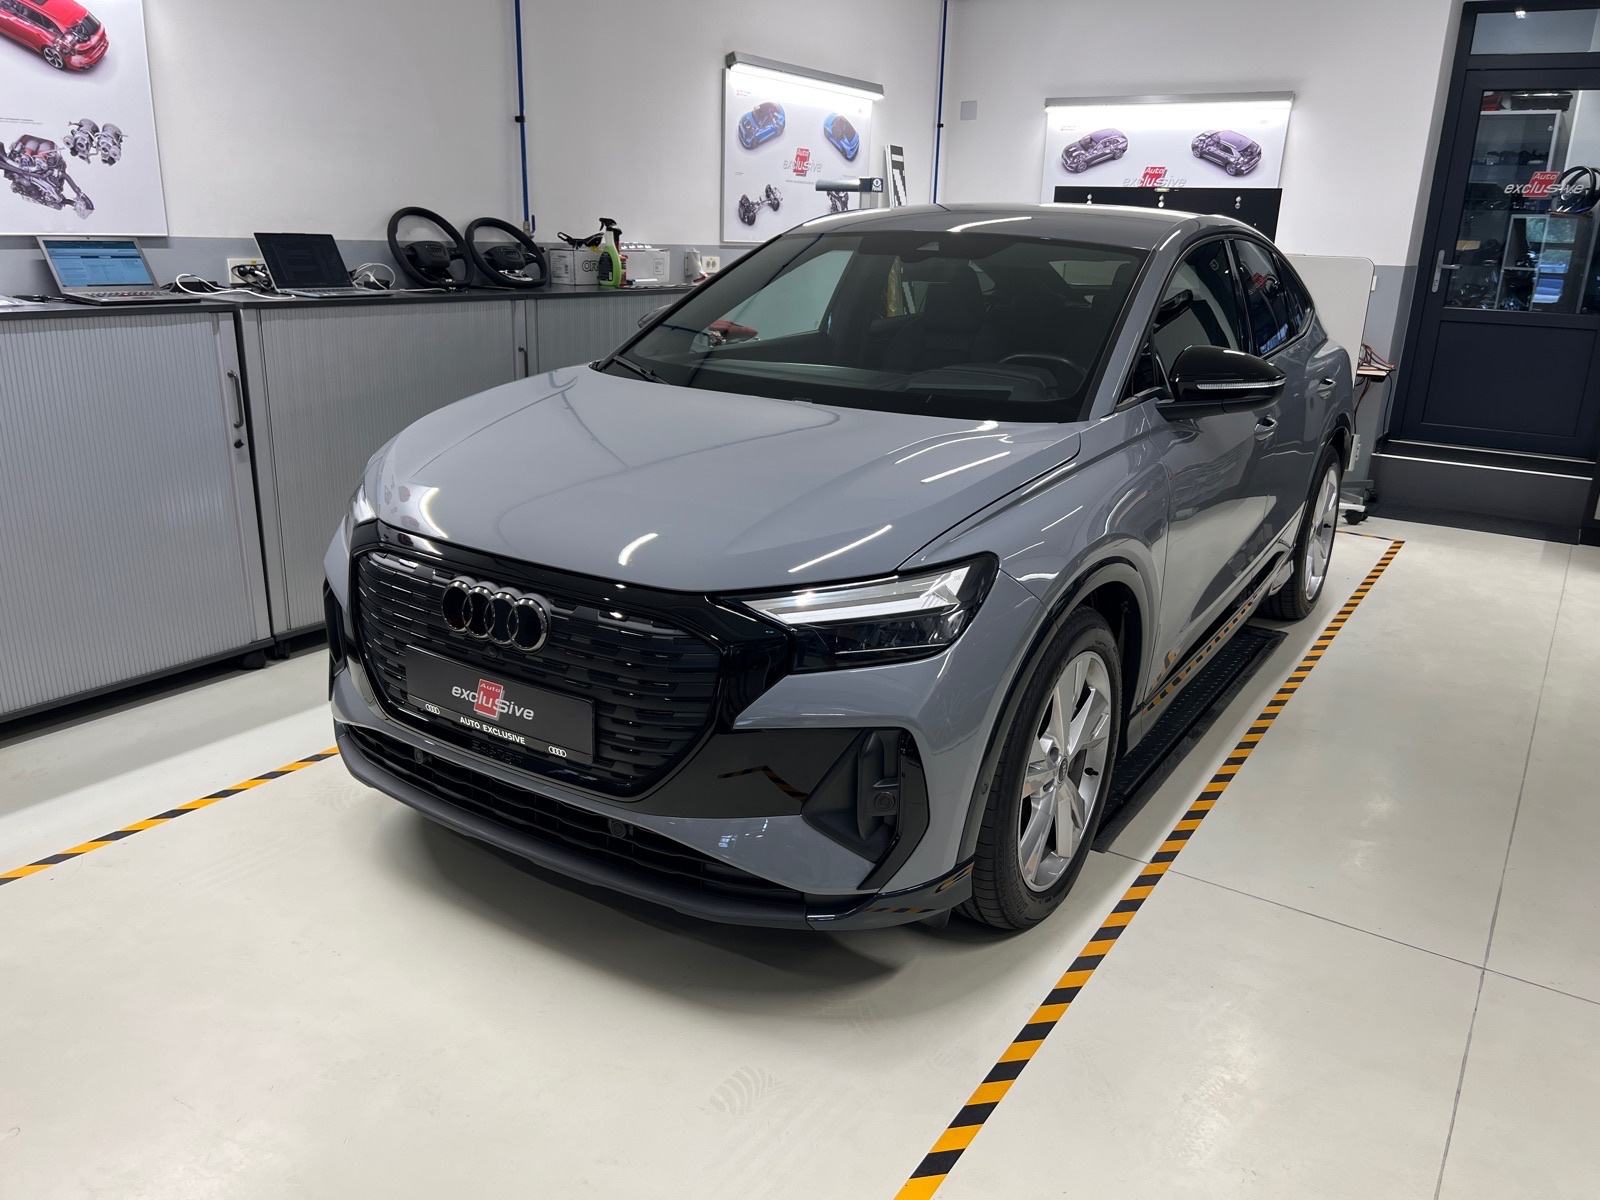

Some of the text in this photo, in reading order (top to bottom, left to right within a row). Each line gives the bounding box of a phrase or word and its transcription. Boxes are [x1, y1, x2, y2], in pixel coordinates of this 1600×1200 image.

[1504, 181, 1584, 194] exclusive
[480, 683, 501, 693] Auto
[460, 716, 526, 745] AUTO EXCLUSIVE
